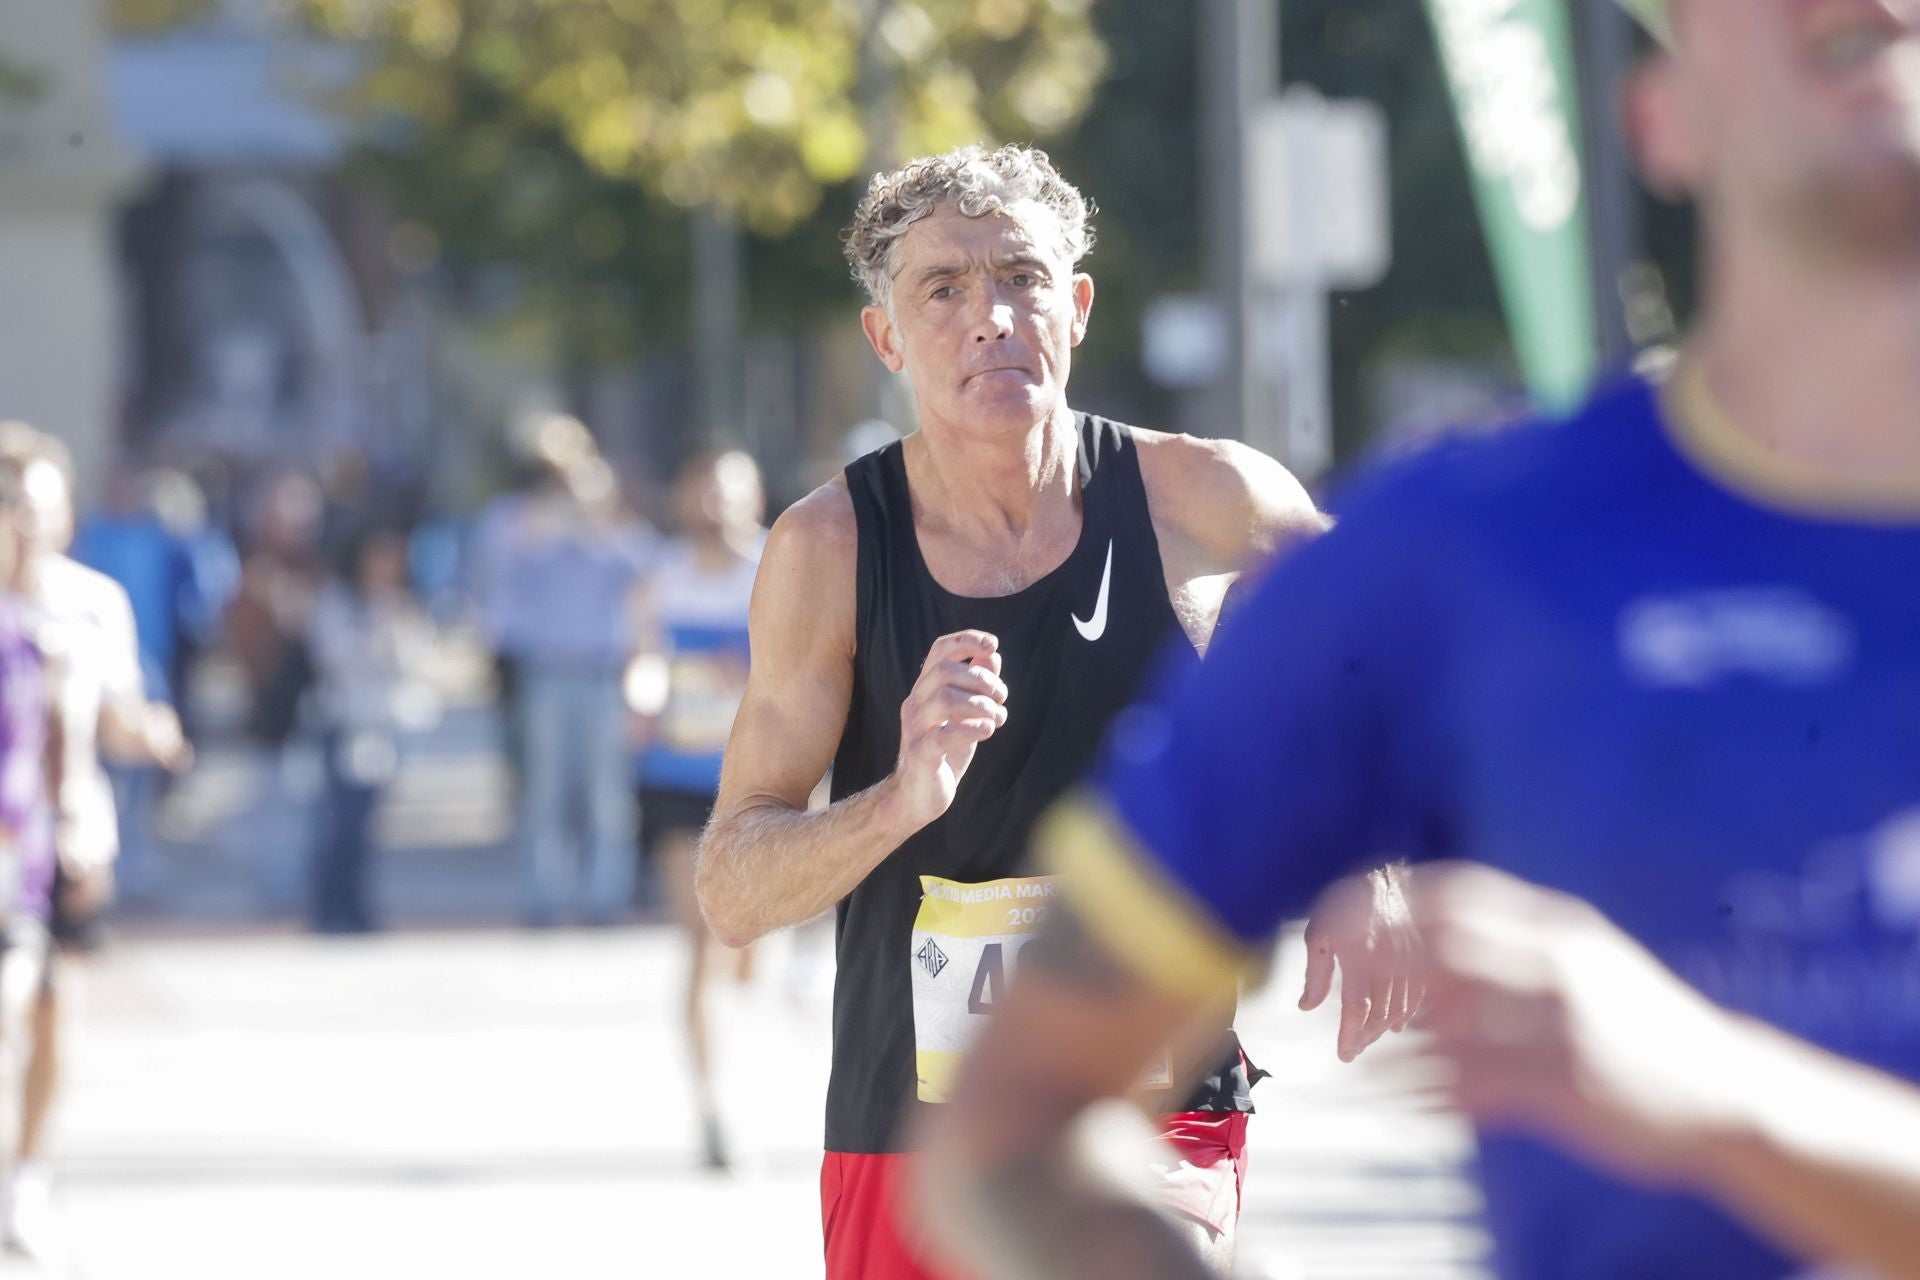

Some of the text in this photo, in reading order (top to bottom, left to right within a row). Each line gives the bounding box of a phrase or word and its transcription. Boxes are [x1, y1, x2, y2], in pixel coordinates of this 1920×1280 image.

[961, 885, 1013, 904] MEDIA
[1016, 882, 1056, 898] MAR
[1008, 906, 1050, 926] 202
